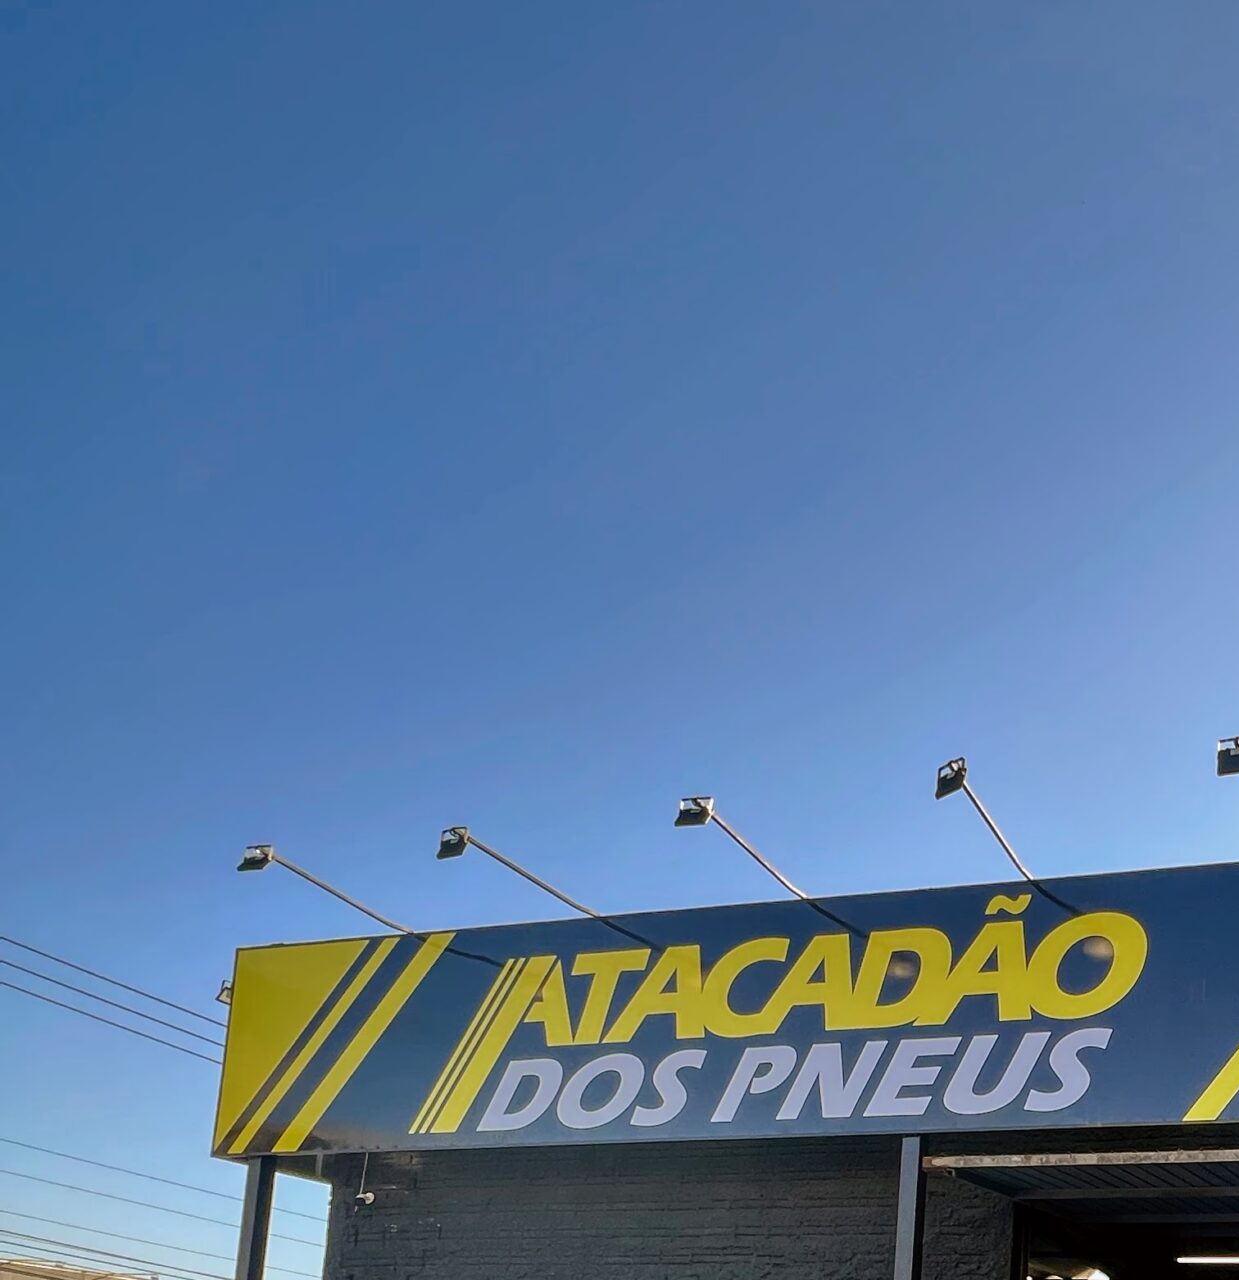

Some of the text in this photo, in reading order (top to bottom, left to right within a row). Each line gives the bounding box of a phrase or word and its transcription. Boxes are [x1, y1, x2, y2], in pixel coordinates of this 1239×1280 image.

[506, 894, 1149, 1046] ATACADÃO
[477, 1028, 1113, 1132] DOS PNEUS
